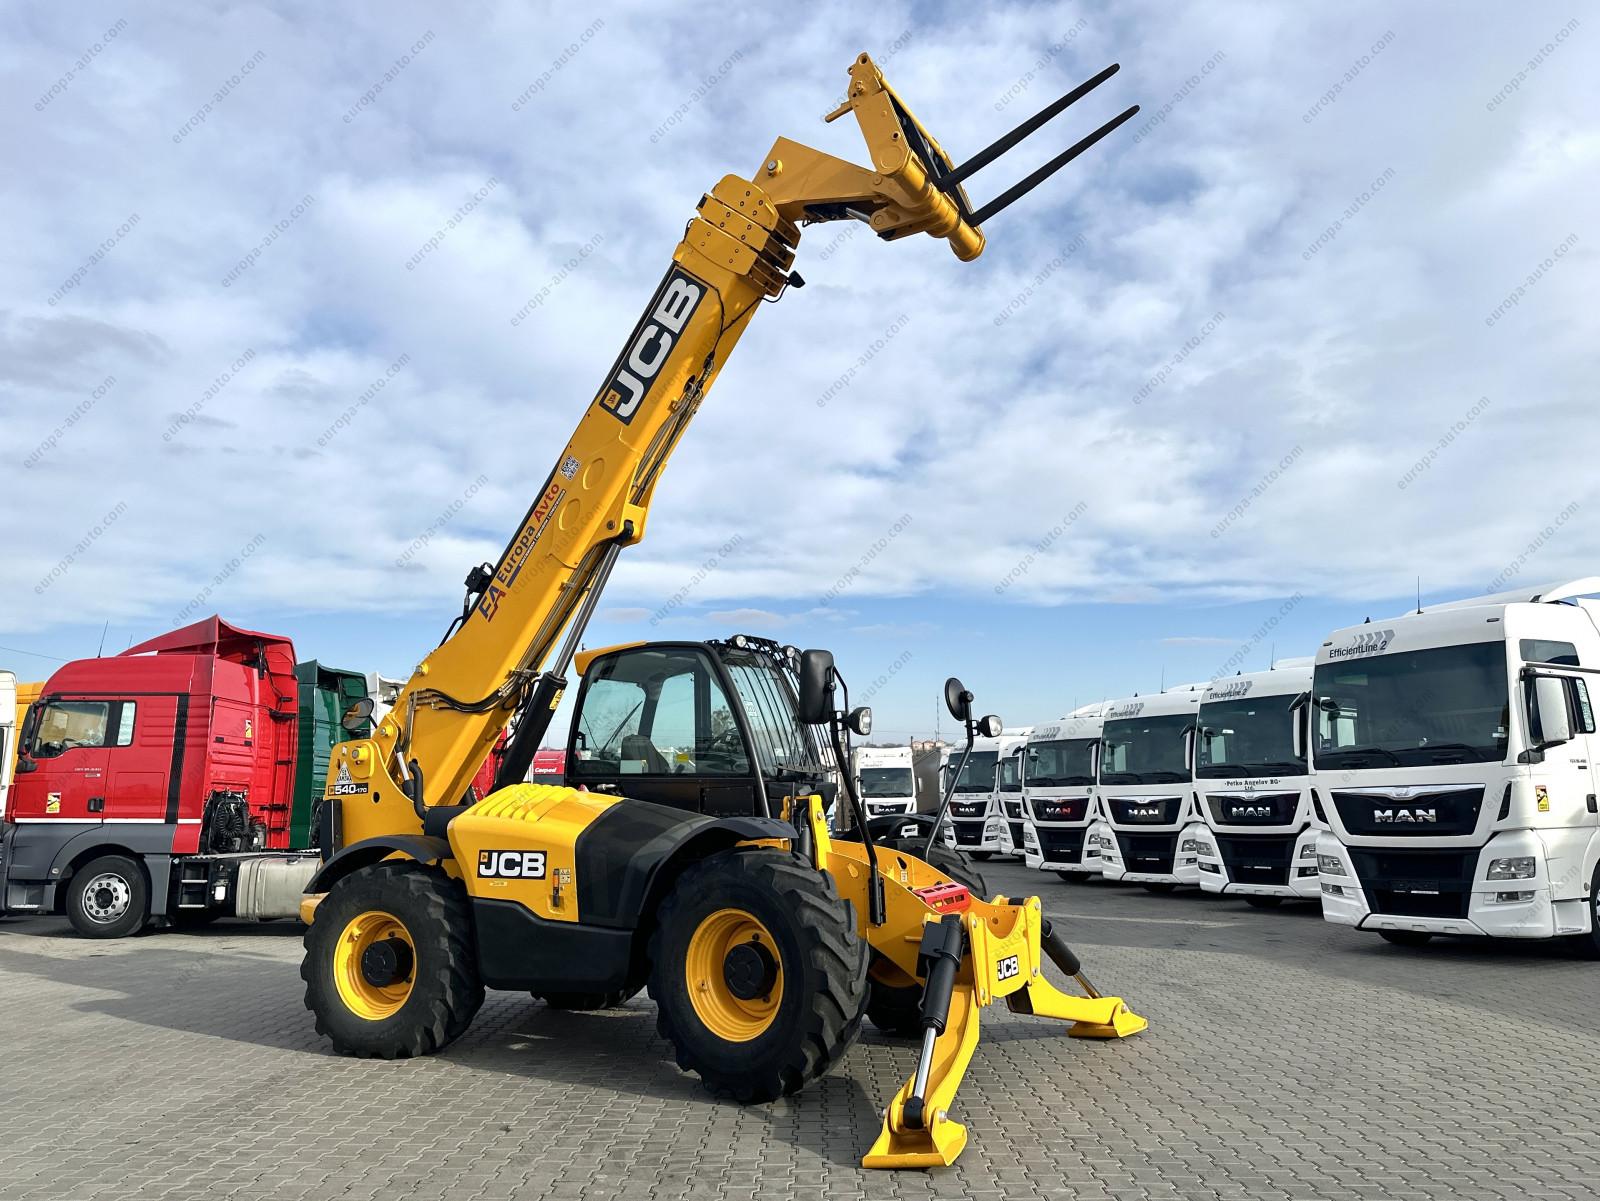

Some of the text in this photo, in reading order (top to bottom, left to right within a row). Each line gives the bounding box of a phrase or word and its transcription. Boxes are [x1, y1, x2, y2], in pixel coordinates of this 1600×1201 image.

[616, 278, 700, 417] JCB
[498, 525, 536, 582] Europa
[534, 483, 559, 523] Avto
[1329, 640, 1388, 659] EfficientLine 2
[1241, 688, 1248, 696] 2
[1128, 808, 1159, 816] MAN
[1231, 806, 1271, 817] MAN
[1374, 808, 1437, 823] MAN
[479, 852, 545, 877] JCB
[998, 956, 1019, 979] JCB
